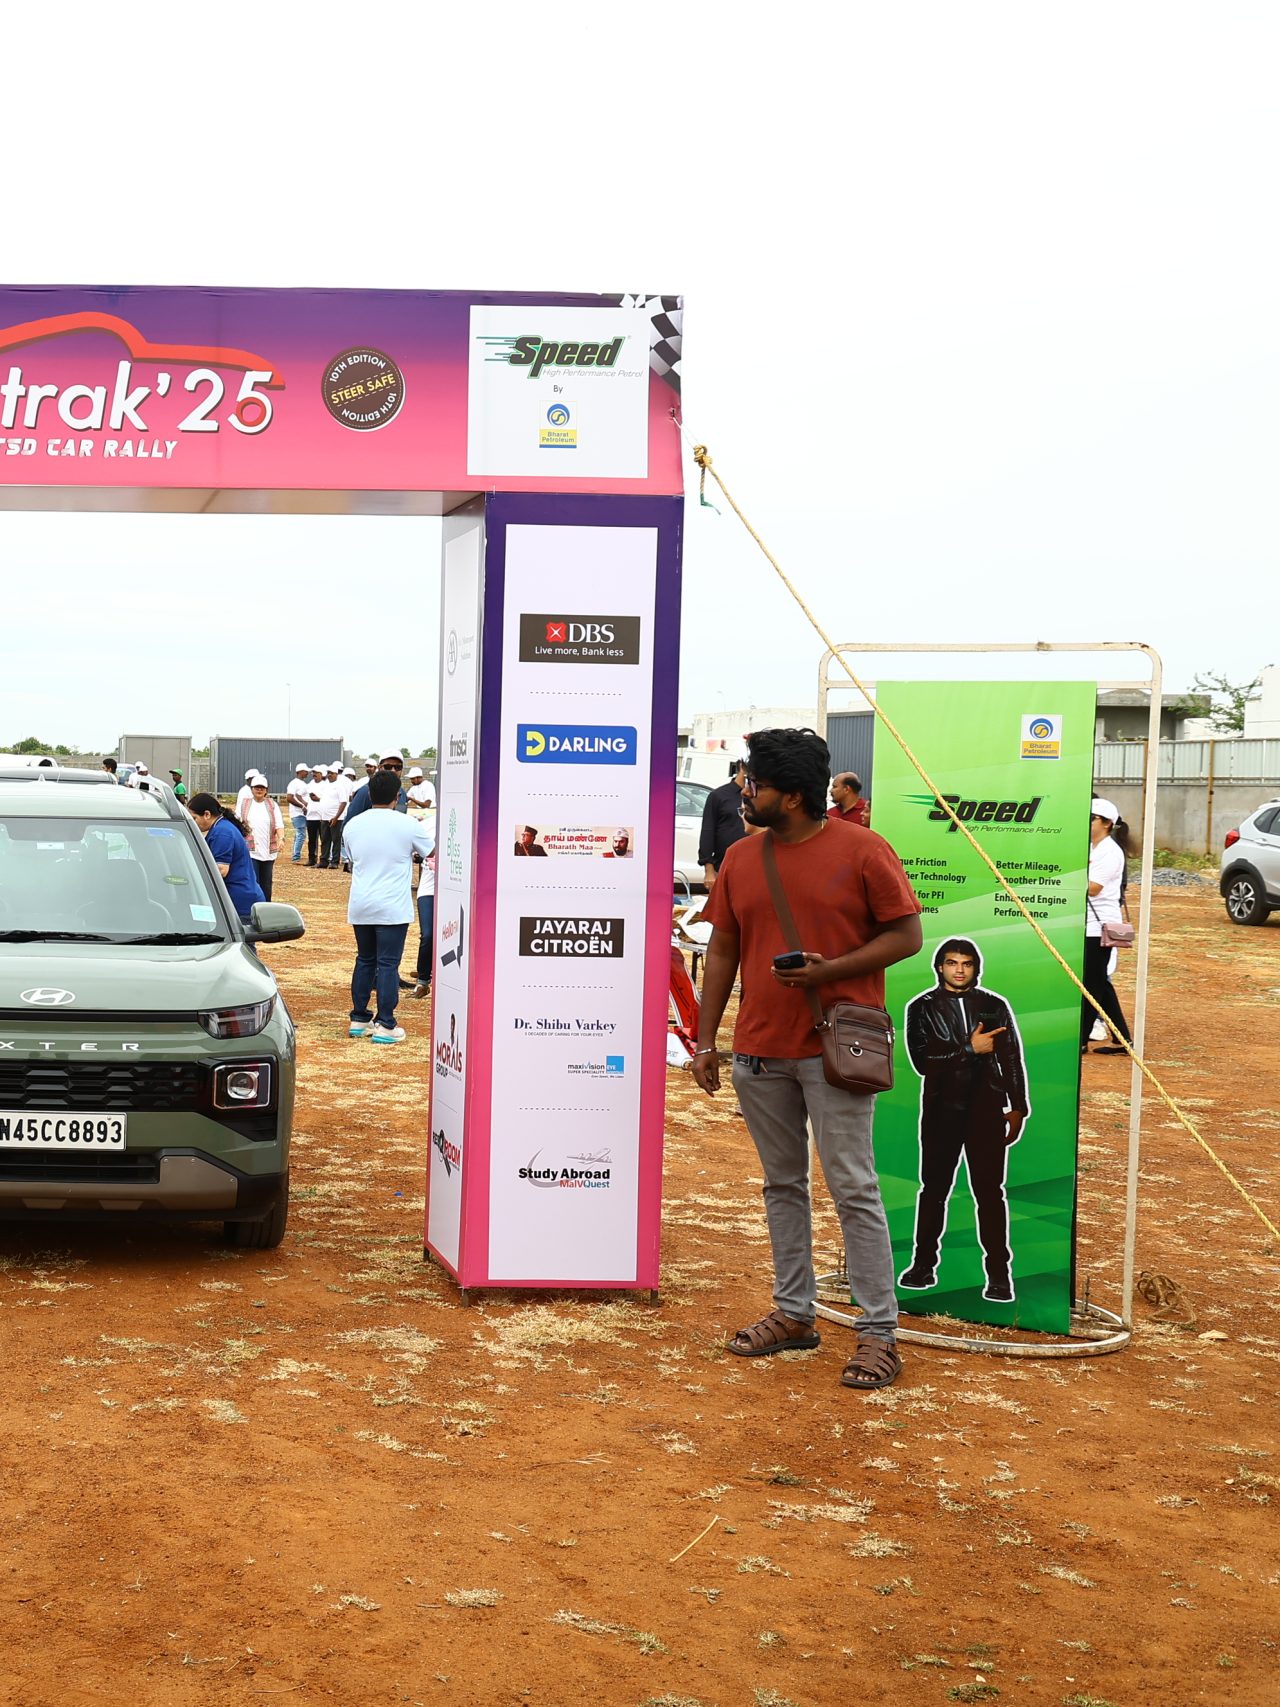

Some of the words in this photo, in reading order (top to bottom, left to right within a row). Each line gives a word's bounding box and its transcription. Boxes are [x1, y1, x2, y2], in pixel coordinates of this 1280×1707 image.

[508, 335, 625, 379] Speed
[329, 361, 347, 382] 10TH
[347, 354, 386, 369] EDITION
[542, 369, 561, 377] High
[563, 369, 616, 377] Performance
[617, 370, 643, 378] Petrol
[331, 385, 365, 404] STEER
[366, 373, 396, 391] SAFE
[553, 385, 563, 394] By
[380, 392, 397, 414] 10TH
[341, 408, 381, 422] EDITION
[46, 438, 94, 457] CAR
[103, 439, 178, 459] RALLY
[568, 623, 615, 643] DBS
[535, 646, 553, 655] Live
[554, 648, 580, 657] more,
[582, 647, 604, 656] Bank
[605, 647, 624, 657] less
[548, 736, 627, 753] DARLING
[916, 857, 947, 867] Friction
[996, 860, 1023, 870] Better
[1025, 861, 1062, 873] Mileage,
[920, 872, 967, 884] Technology
[995, 876, 1037, 885] Soother
[1039, 877, 1062, 886] Drive
[917, 890, 930, 899] for
[931, 891, 945, 899] PFI
[1037, 894, 1067, 906] Engine
[533, 920, 611, 936] JAYARAJ
[530, 937, 613, 955] CITROËN
[514, 1018, 532, 1029] Dr.
[536, 1018, 571, 1030] Shibu
[575, 1019, 617, 1034] Varkey
[518, 1167, 558, 1181] Study
[560, 1168, 610, 1179] Abroad
[560, 1180, 610, 1188] MalVQuest
